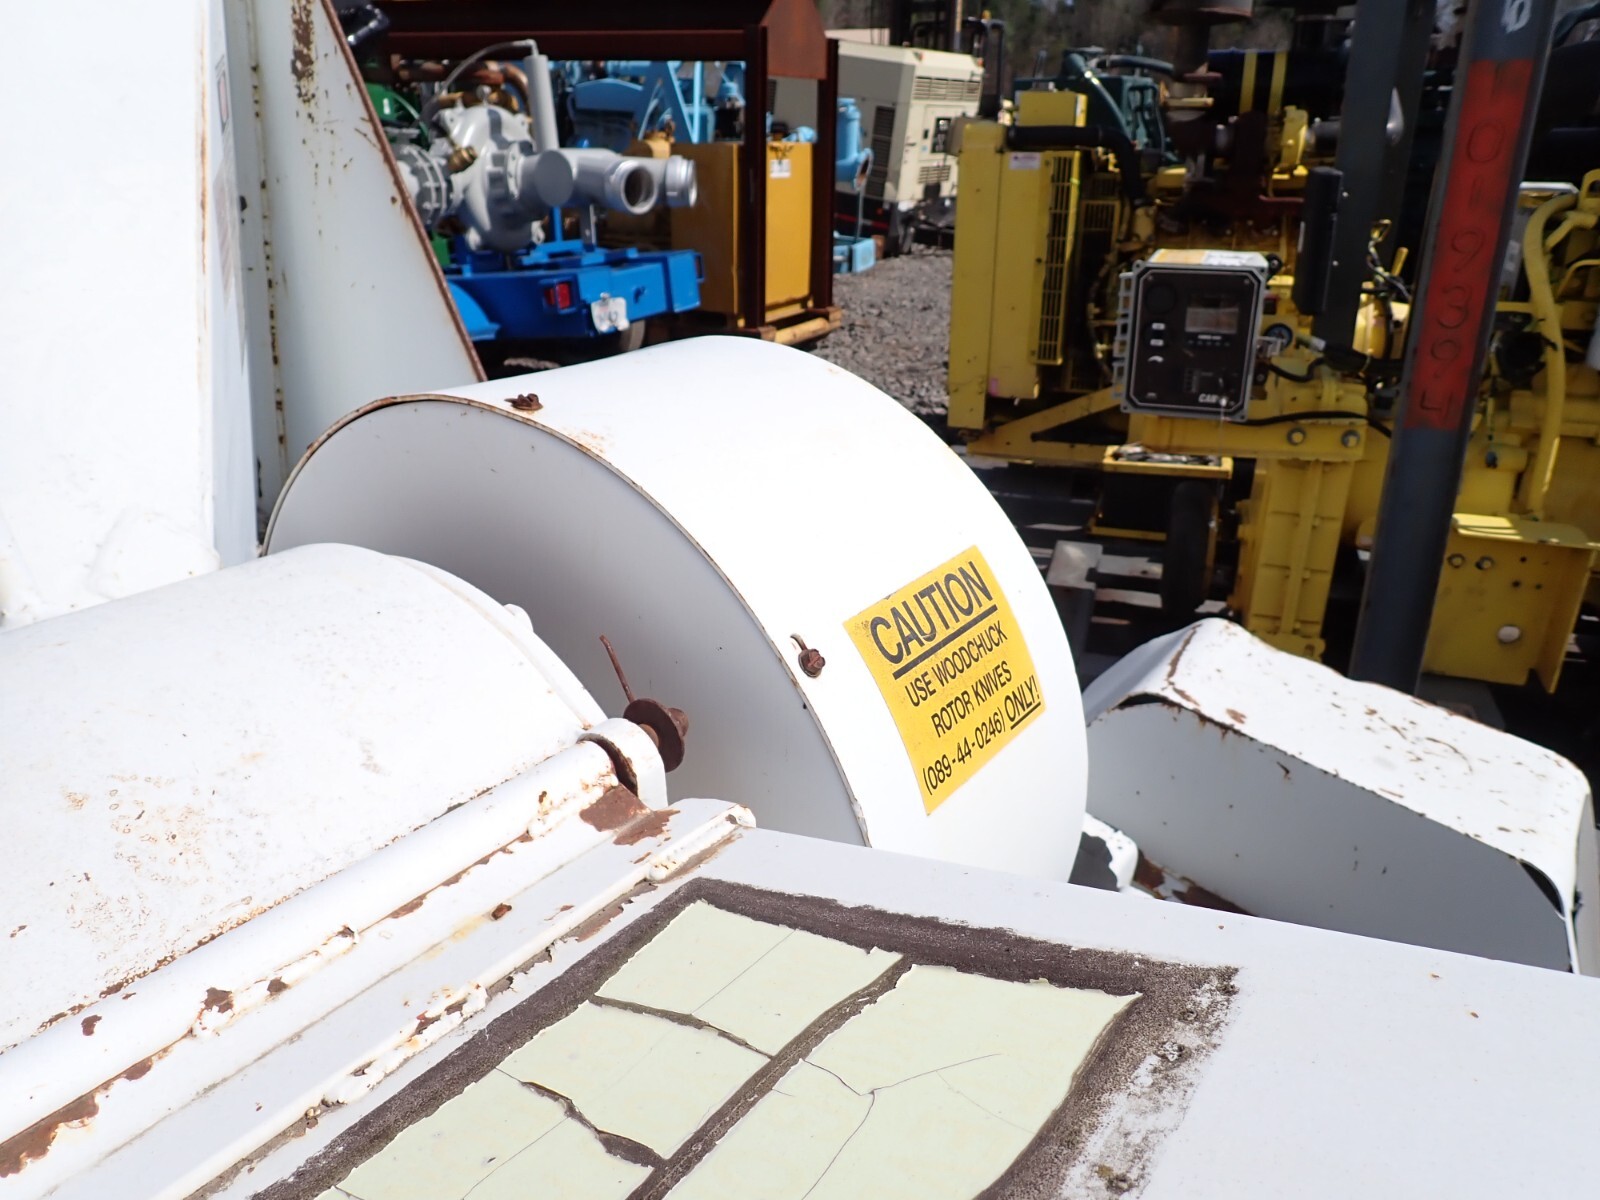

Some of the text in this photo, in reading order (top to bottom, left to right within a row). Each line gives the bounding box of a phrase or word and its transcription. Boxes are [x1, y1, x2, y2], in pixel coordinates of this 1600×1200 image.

[870, 561, 993, 664] CAUTION
[905, 621, 1008, 707] USE WOODCHUCK
[930, 660, 1013, 738] ROTOR KNIVES
[1004, 674, 1040, 722] ONLY!
